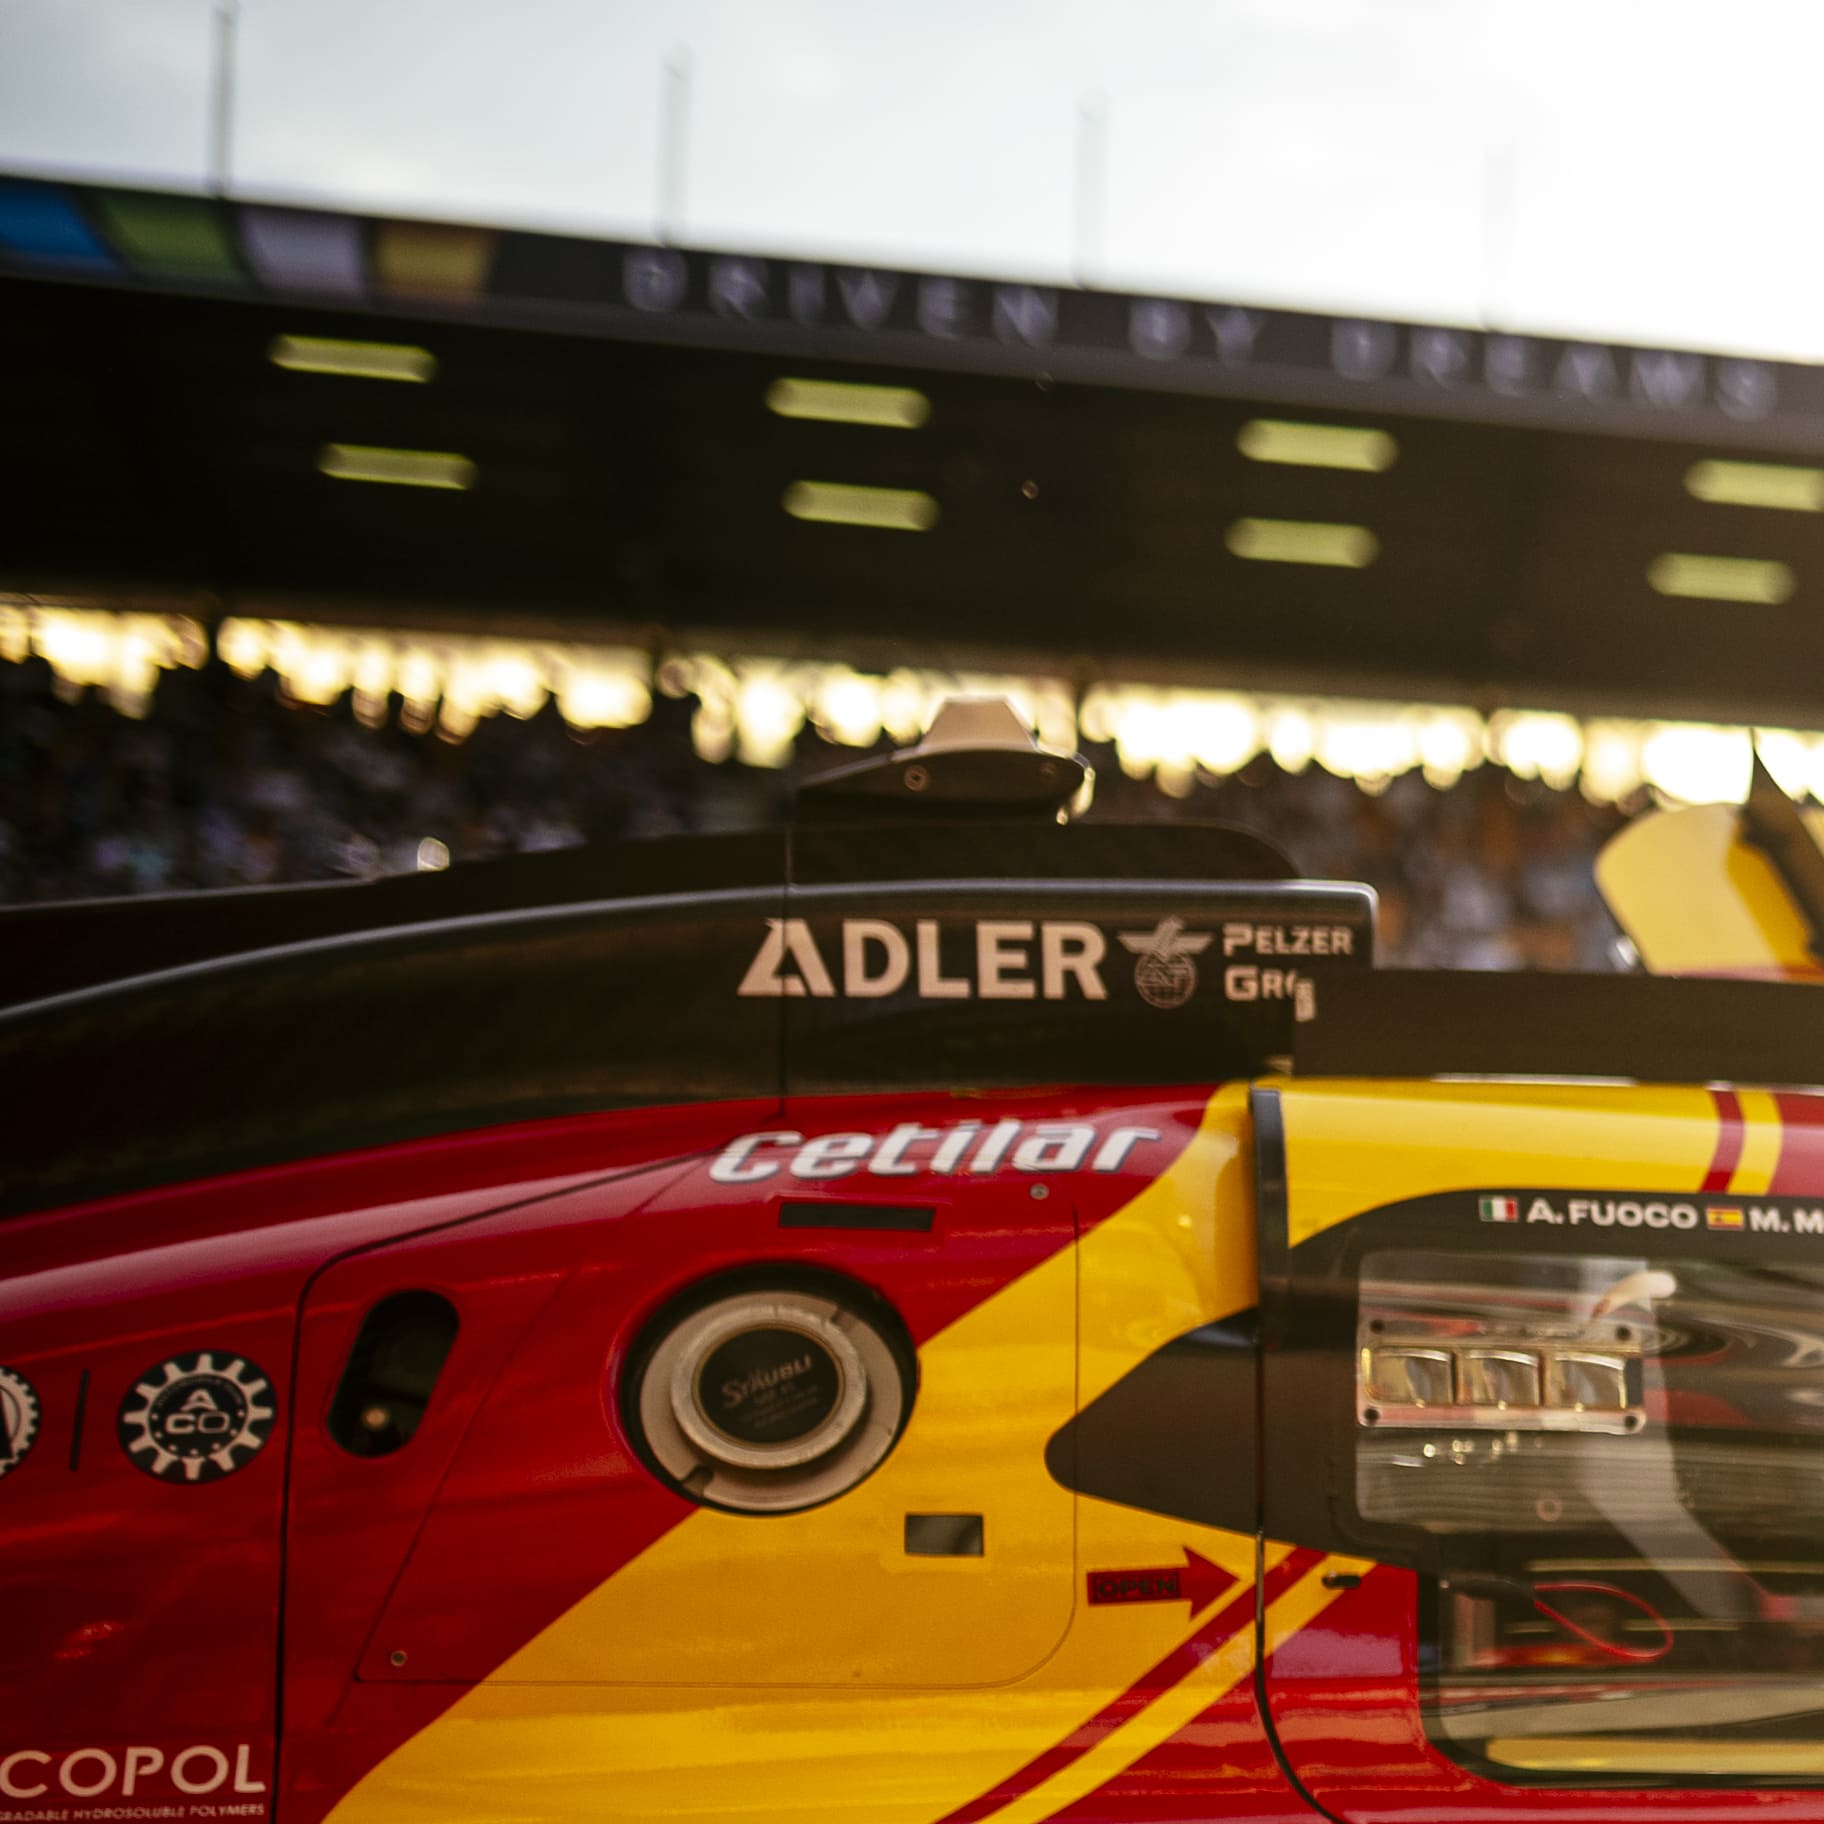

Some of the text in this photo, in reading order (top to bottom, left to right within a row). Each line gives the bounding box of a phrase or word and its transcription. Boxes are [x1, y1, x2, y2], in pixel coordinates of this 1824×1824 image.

[1222, 922, 1353, 956] PELZER
[737, 919, 1108, 999] ADLER
[1526, 1201, 1564, 1225] A.
[1569, 1203, 1698, 1229] FUOCO
[1750, 1208, 1790, 1233] M.
[1100, 1578, 1176, 1597] OPEN
[190, 1804, 265, 1818] POLYMERS
